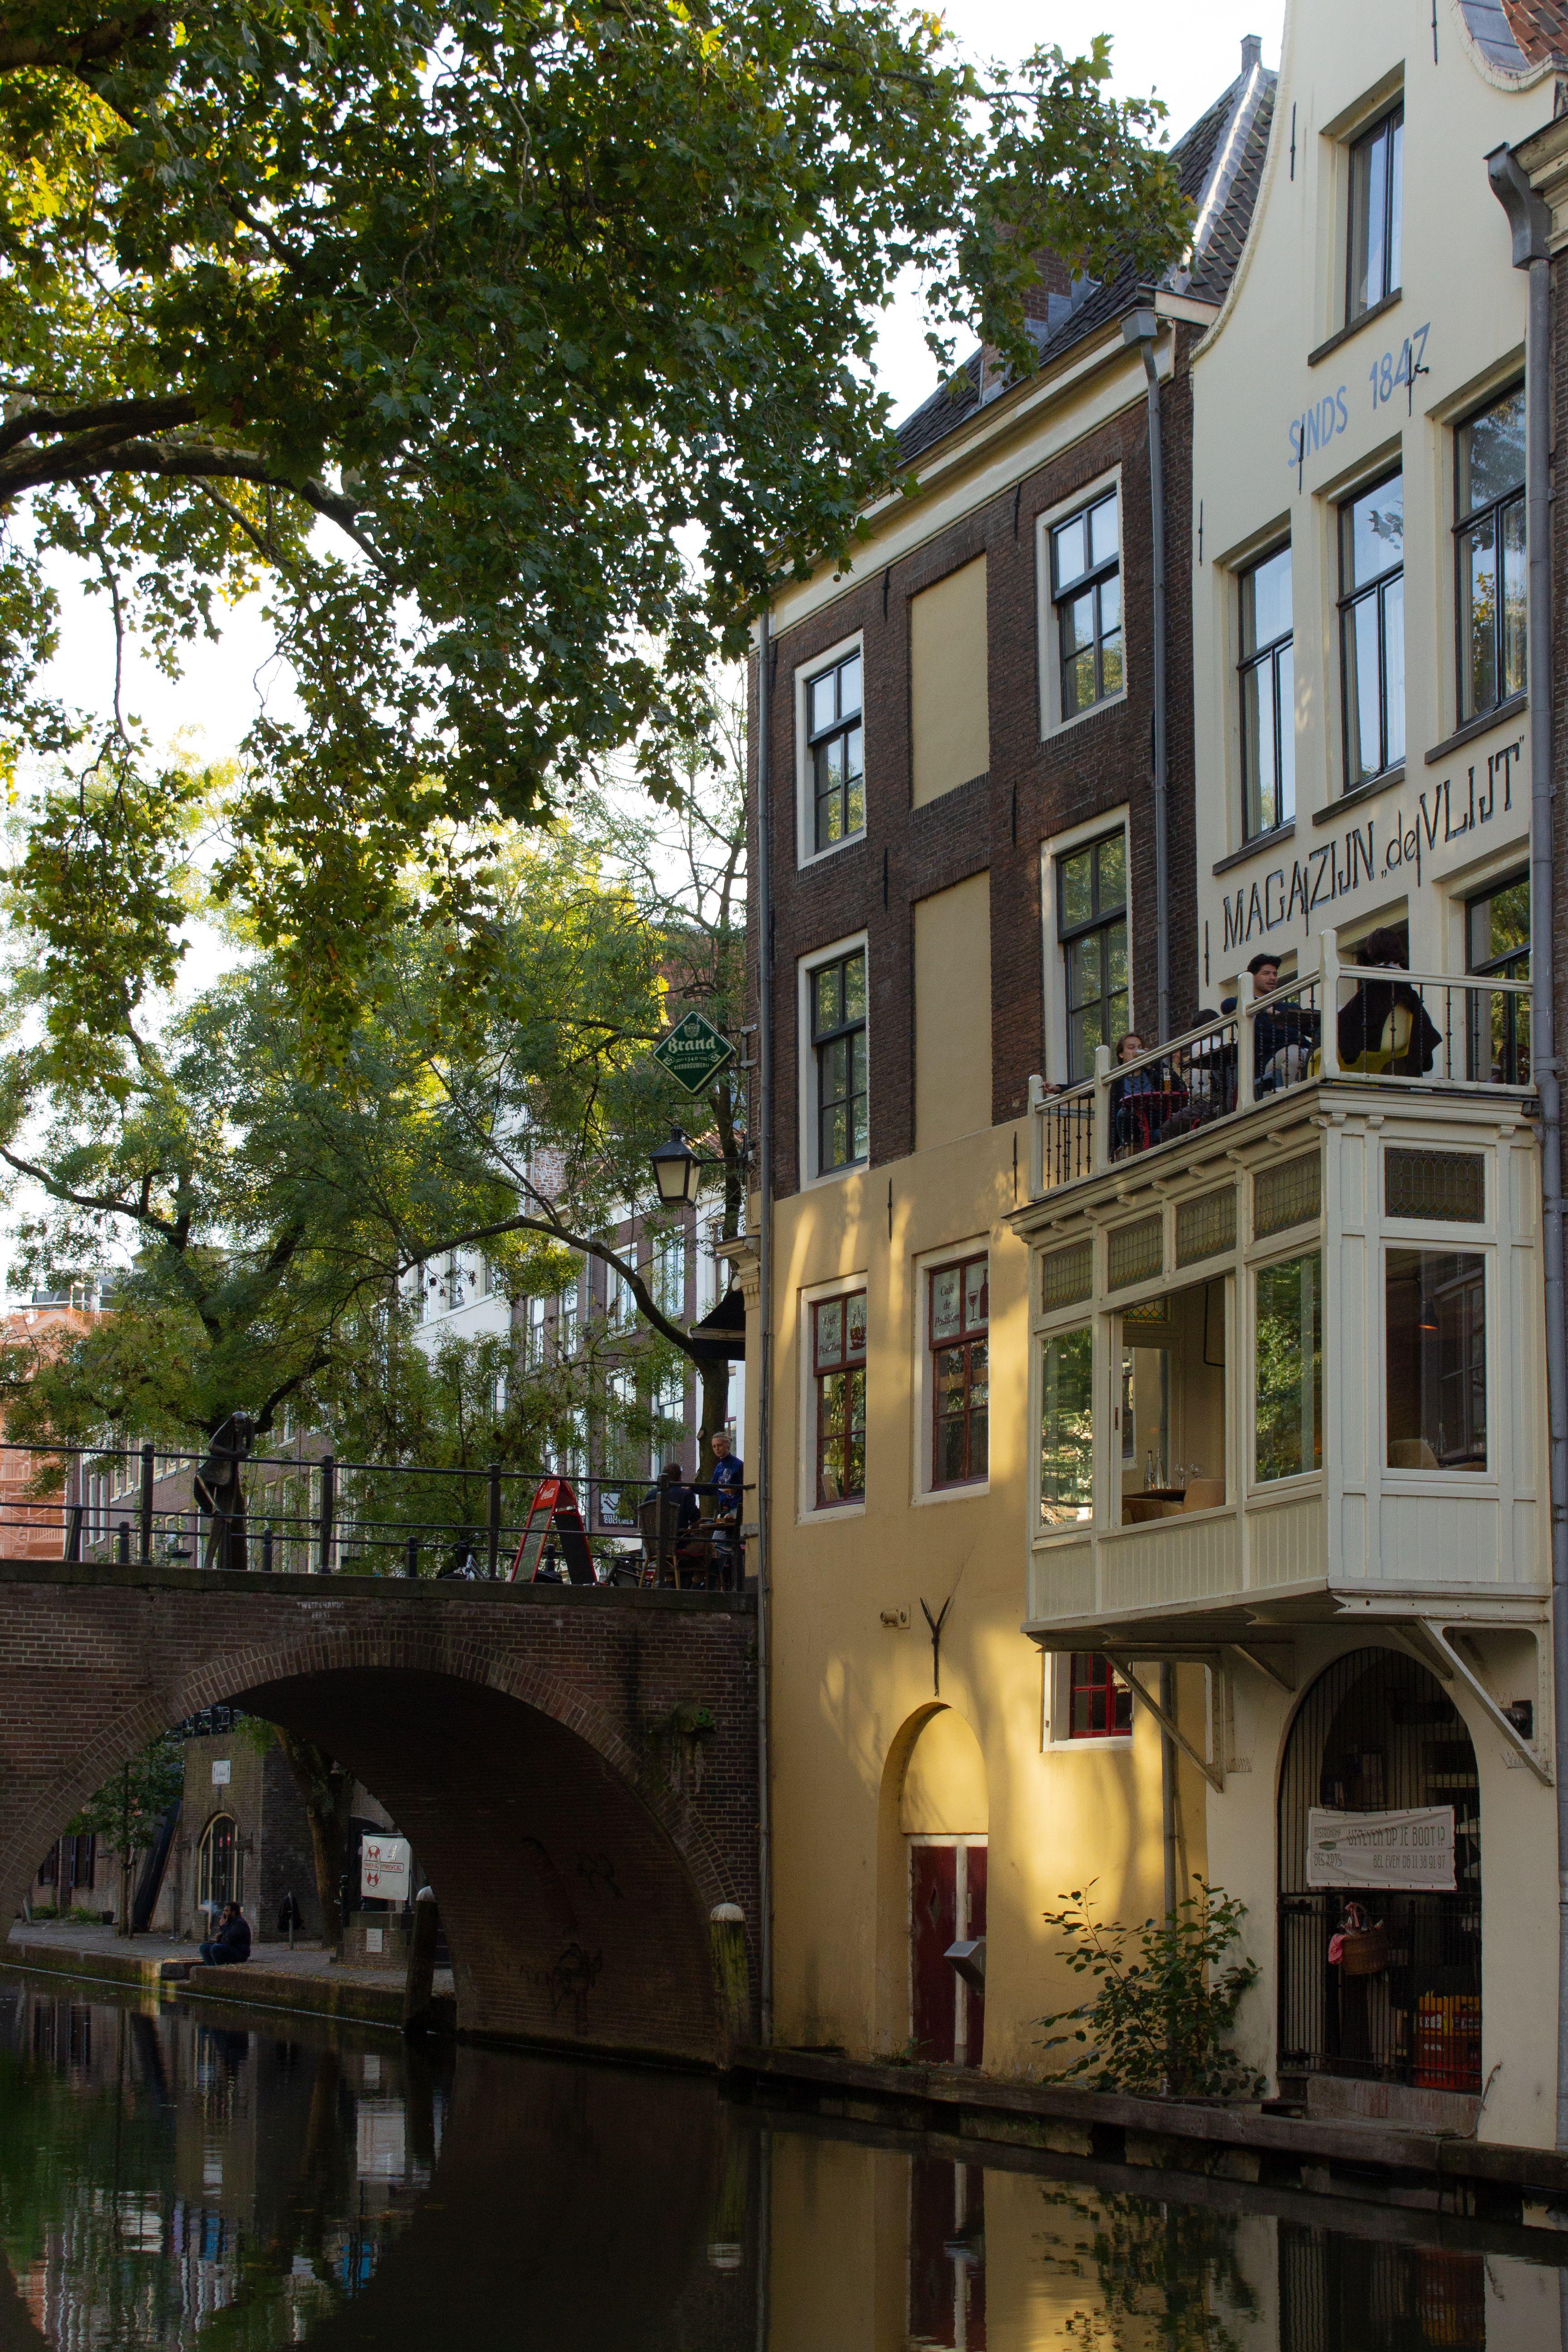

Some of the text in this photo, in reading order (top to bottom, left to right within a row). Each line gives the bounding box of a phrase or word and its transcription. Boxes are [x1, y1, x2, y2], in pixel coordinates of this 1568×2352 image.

[1288, 322, 1431, 468] SINDS 1847
[1223, 821, 1375, 952] MAGAZIJN
[668, 1036, 716, 1054] Brand
[941, 1283, 954, 1297] Café
[944, 1300, 951, 1310] de
[1386, 1828, 1398, 1846] OP
[1400, 1827, 1409, 1846] JE
[1412, 1826, 1436, 1846] BOOT
[1373, 1855, 1383, 1868] BEL
[1385, 1855, 1400, 1869] EVEN
[1402, 1855, 1411, 1869] 06
